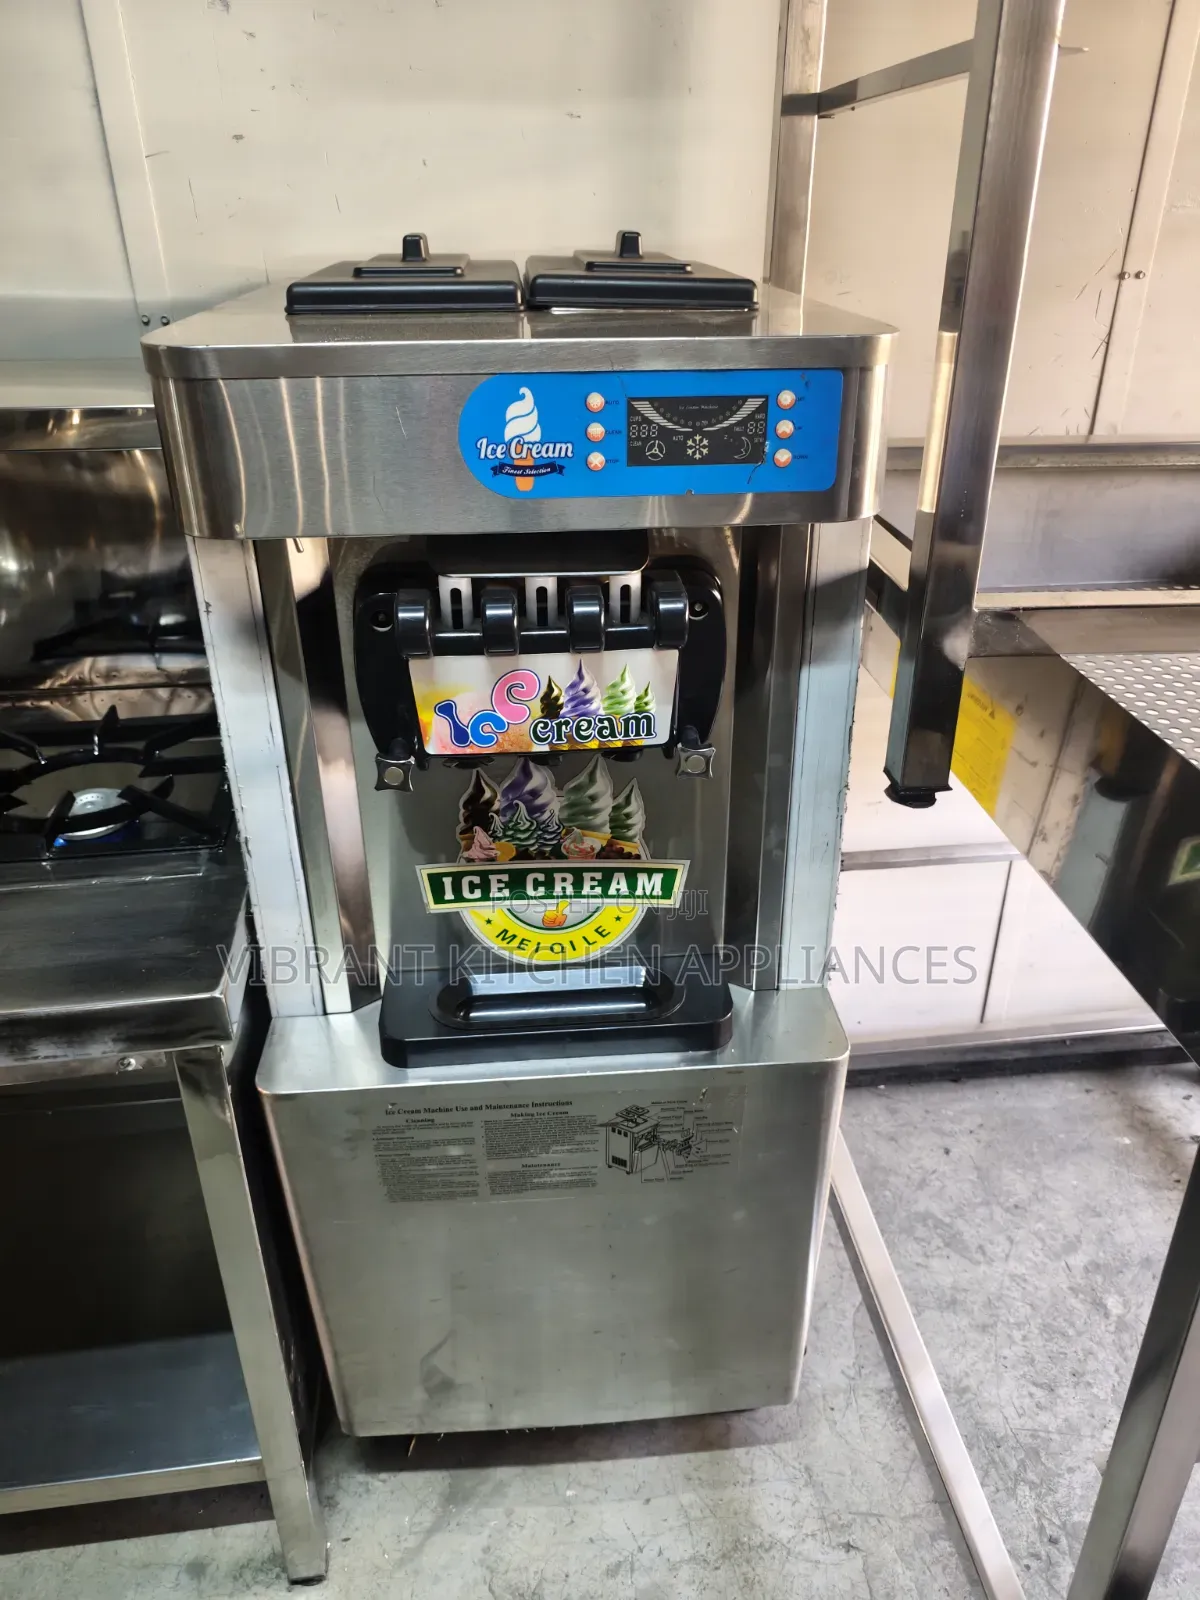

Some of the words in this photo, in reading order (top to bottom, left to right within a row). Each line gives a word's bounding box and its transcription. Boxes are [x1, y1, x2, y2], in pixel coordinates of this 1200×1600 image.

[476, 437, 507, 460] Ice
[508, 436, 574, 460] Cream
[502, 466, 523, 475] Finest
[523, 467, 551, 476] Selection
[529, 712, 657, 746] cream
[442, 872, 510, 900] ICE
[525, 872, 664, 897] CREAM
[496, 925, 611, 955] MEIQILE
[397, 1107, 422, 1115] Cream
[423, 1106, 453, 1114] Machine
[484, 1102, 530, 1110] Maintenance
[531, 1099, 573, 1108] Instructions
